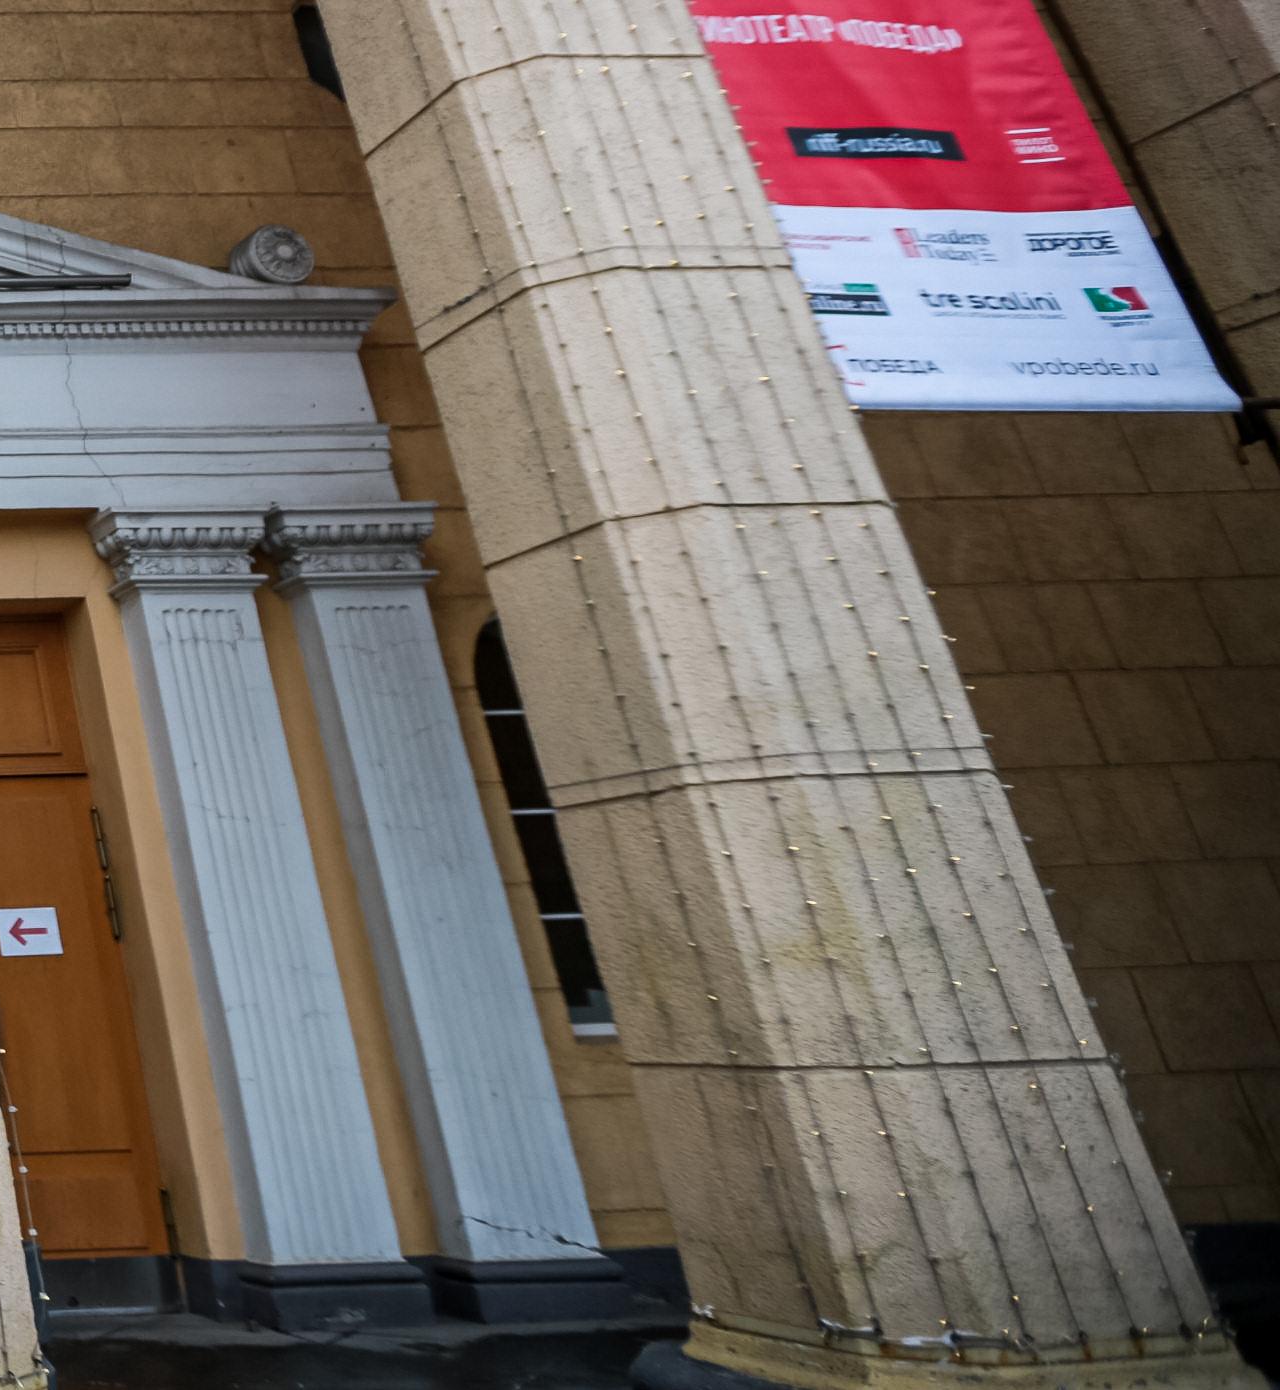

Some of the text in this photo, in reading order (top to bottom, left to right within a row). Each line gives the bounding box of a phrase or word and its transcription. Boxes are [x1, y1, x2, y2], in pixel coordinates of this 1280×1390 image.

[919, 289, 963, 308] tre
[846, 358, 944, 374] ПОБЕДА
[1008, 358, 1161, 377] vpobede.ru
